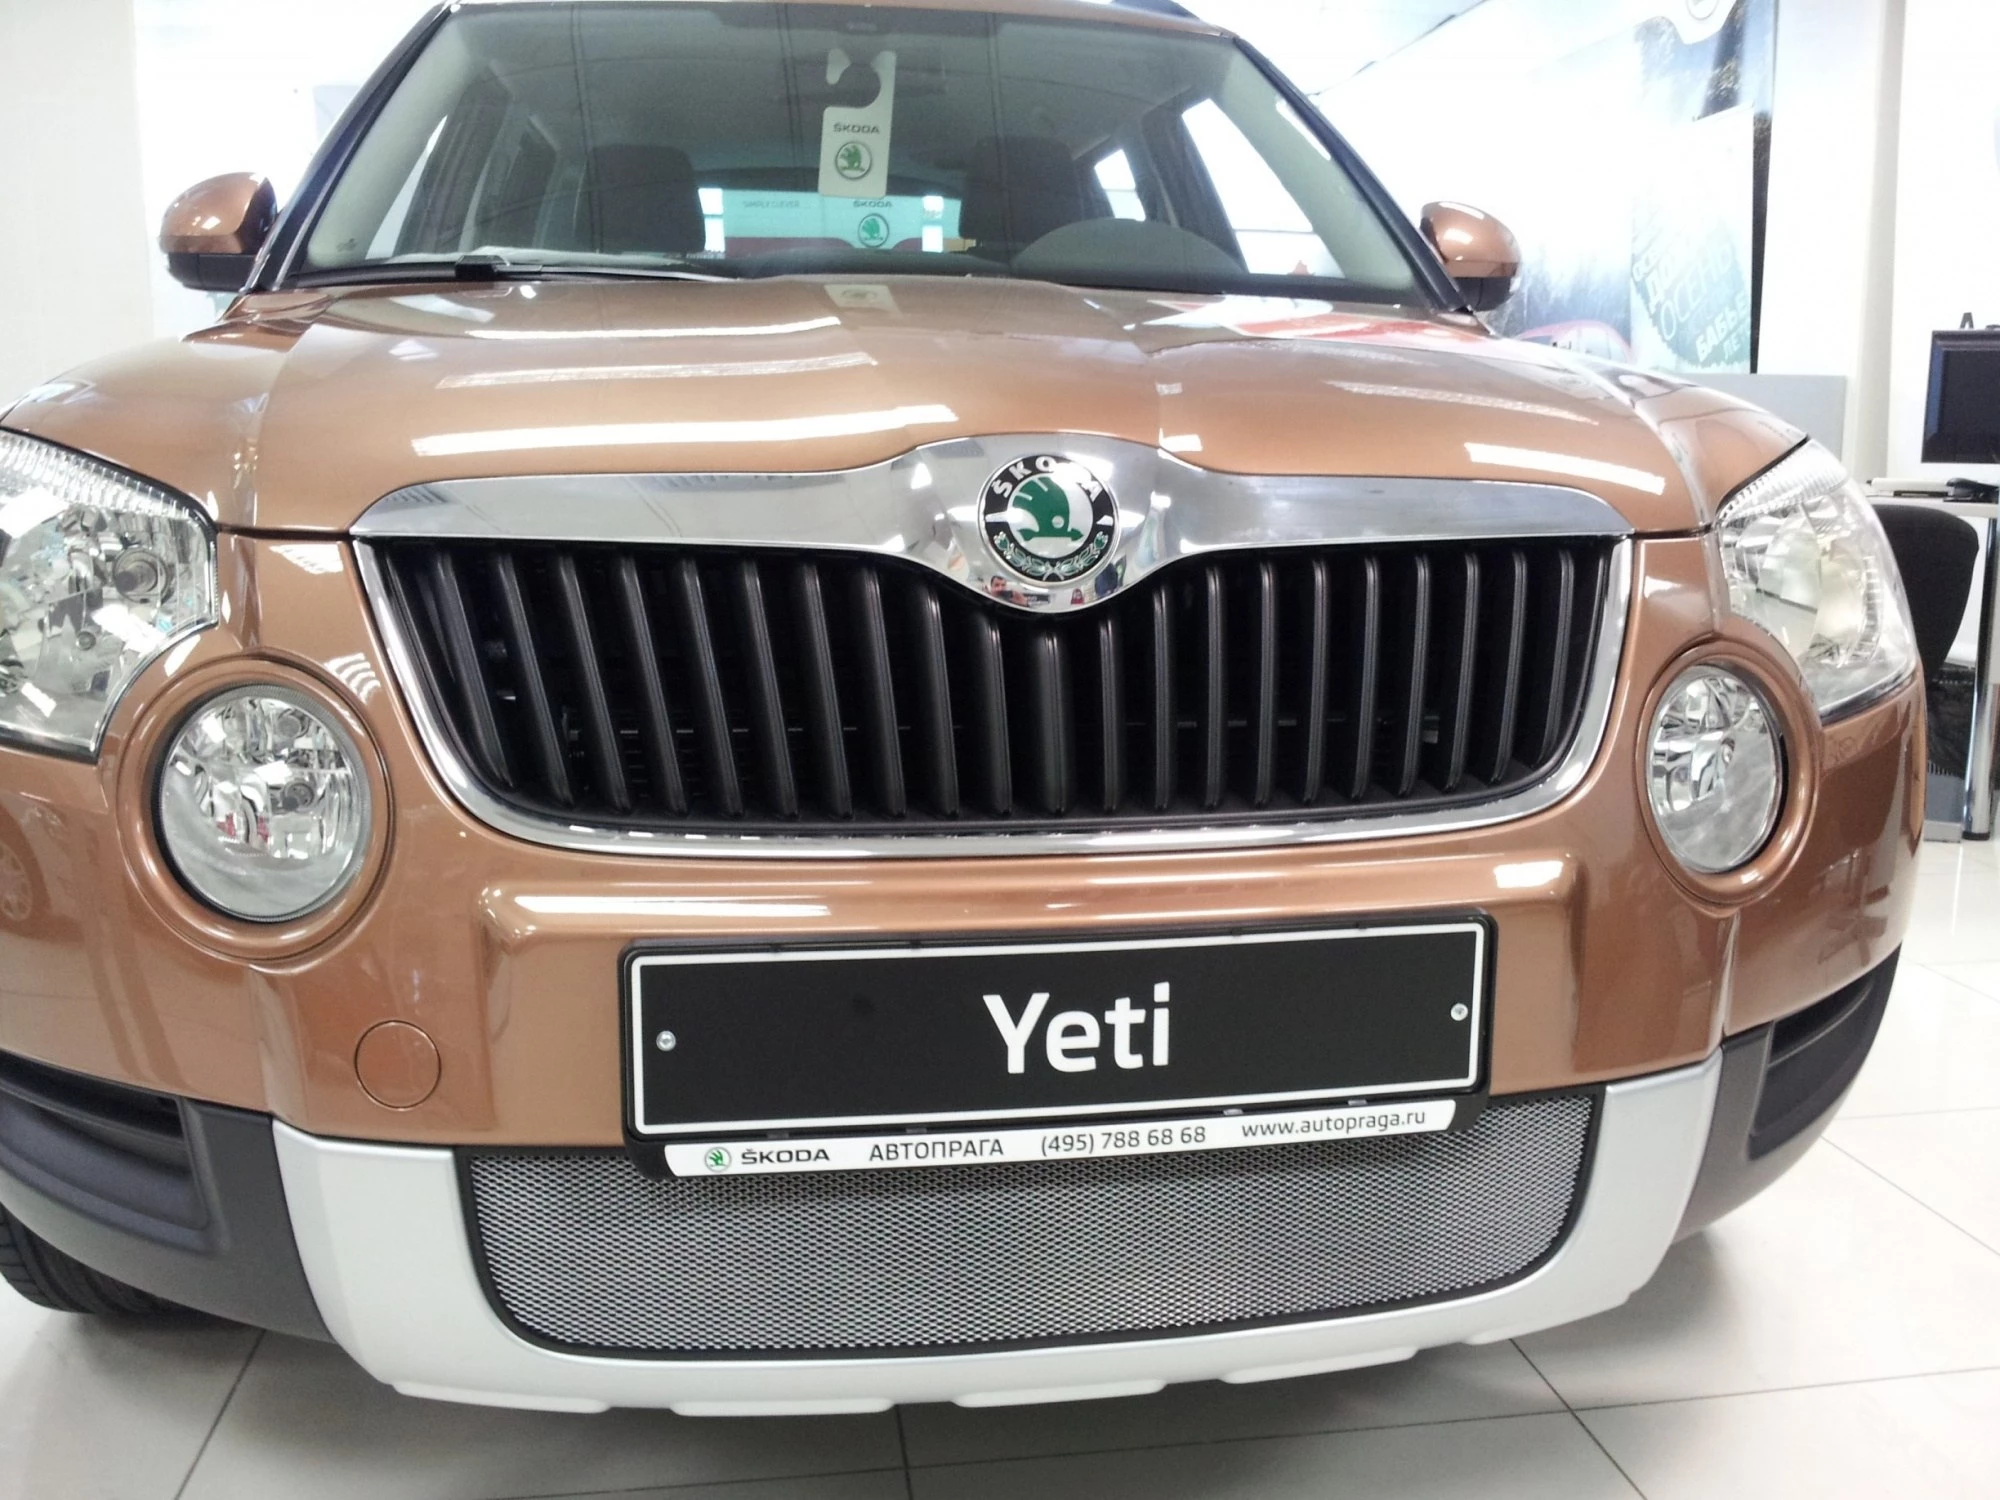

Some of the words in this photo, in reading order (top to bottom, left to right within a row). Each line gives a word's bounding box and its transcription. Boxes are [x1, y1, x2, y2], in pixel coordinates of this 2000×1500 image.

[991, 455, 1104, 502] ŠKOA
[982, 981, 1170, 1074] Yeti
[740, 1148, 831, 1165] ŠKODA
[868, 1138, 1005, 1162] АВТОПРАГА
[1041, 1132, 1094, 1157] (495)
[1101, 1131, 1140, 1150] 788
[1148, 1128, 1173, 1147] 68
[1180, 1126, 1207, 1144] 68
[1241, 1110, 1426, 1139] www.autopraga.ru
